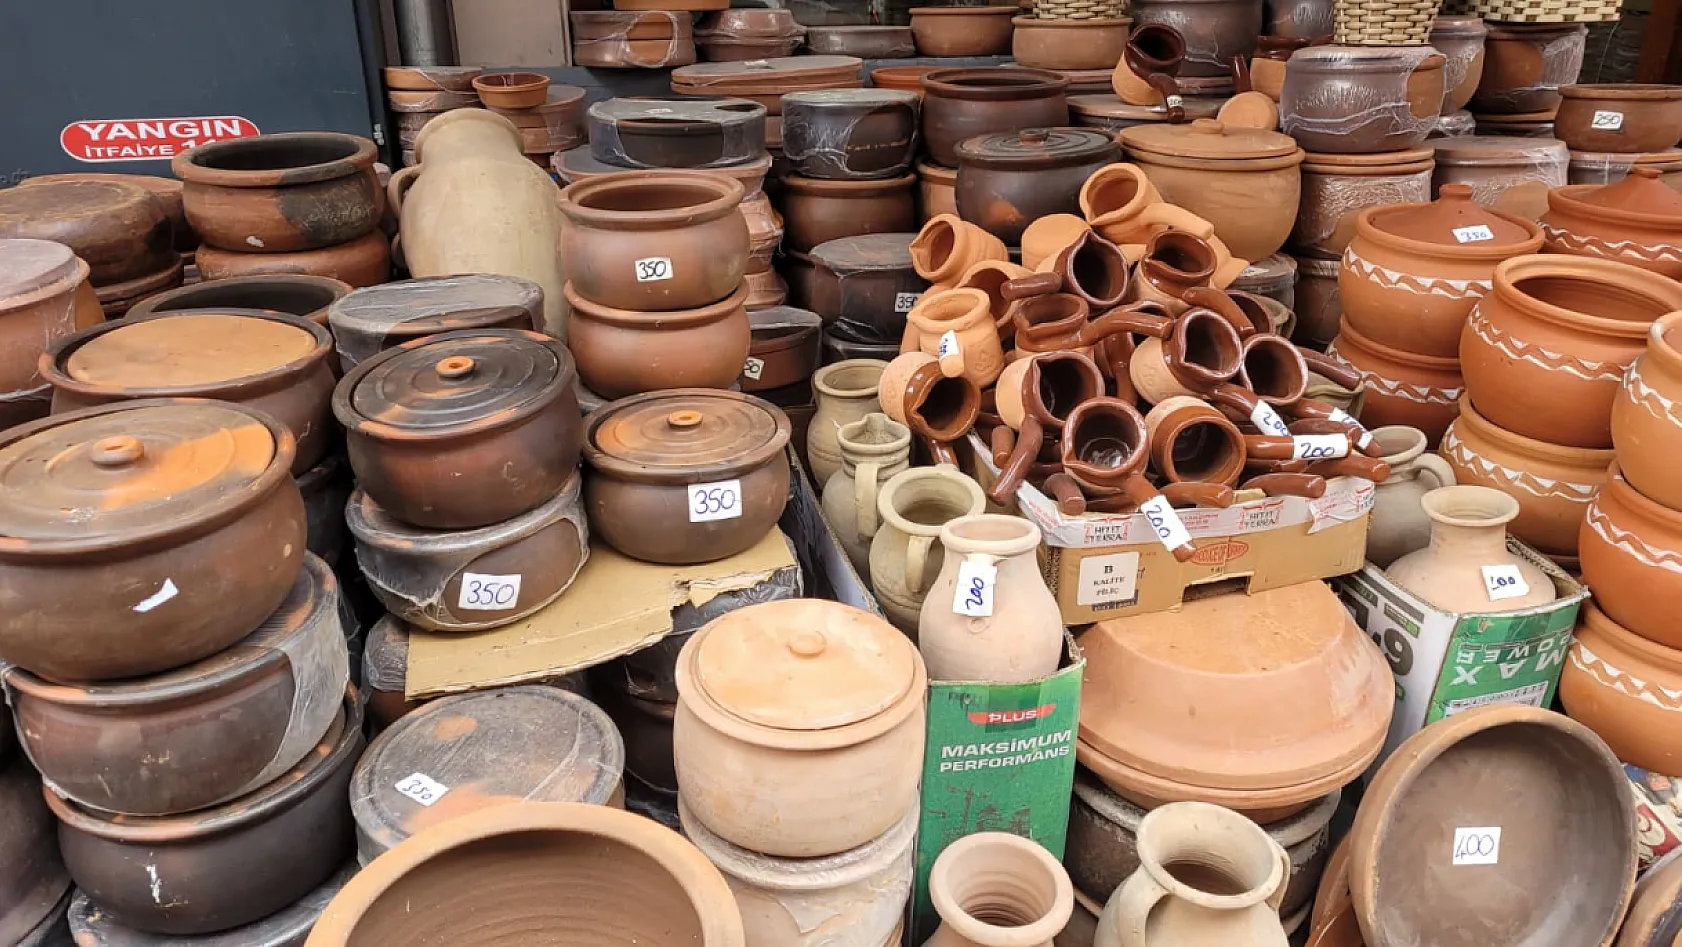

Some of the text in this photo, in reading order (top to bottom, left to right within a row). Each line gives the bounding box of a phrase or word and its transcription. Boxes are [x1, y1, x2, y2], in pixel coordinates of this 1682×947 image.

[78, 119, 242, 141] YANGIN
[84, 142, 175, 157] İTFAİYE
[1459, 230, 1488, 241] 350
[638, 260, 667, 280] 350
[1300, 442, 1336, 459] 200
[694, 487, 736, 515] 350
[1146, 504, 1172, 539] 200
[1104, 565, 1113, 574] B
[467, 580, 515, 605] 350
[965, 576, 985, 611] 200
[1455, 632, 1570, 666] POWER
[1450, 648, 1568, 686] MAX
[988, 709, 1038, 724] PLUS
[941, 729, 1073, 759] MAKSİMUM
[940, 746, 1071, 773] PERFORMANS
[401, 779, 433, 800] 350
[1455, 833, 1495, 860] 400
